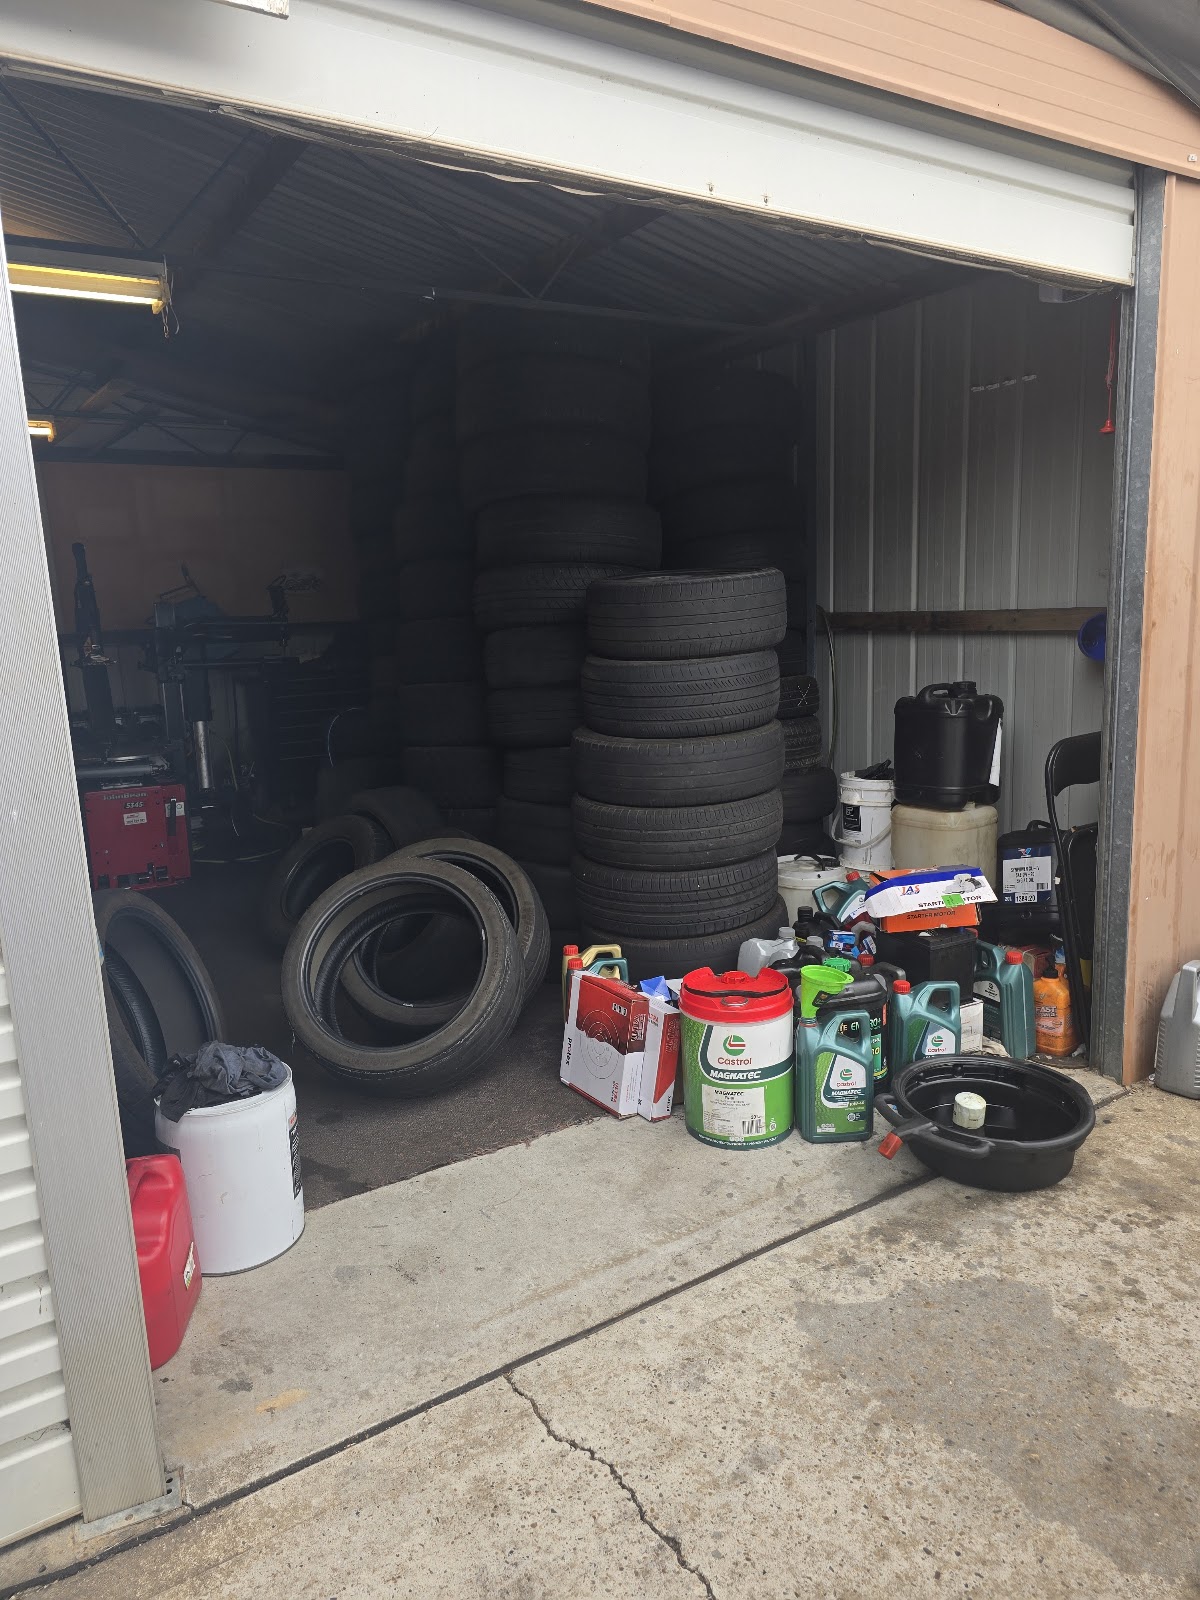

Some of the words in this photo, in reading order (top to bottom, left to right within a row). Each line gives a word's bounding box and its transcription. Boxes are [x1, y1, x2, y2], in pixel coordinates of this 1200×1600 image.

[902, 884, 919, 895] JAS
[906, 911, 932, 919] STARTER
[717, 1057, 752, 1066] Castrol
[709, 1069, 762, 1080] MAGNATEC
[714, 1089, 744, 1097] MAGNATEC
